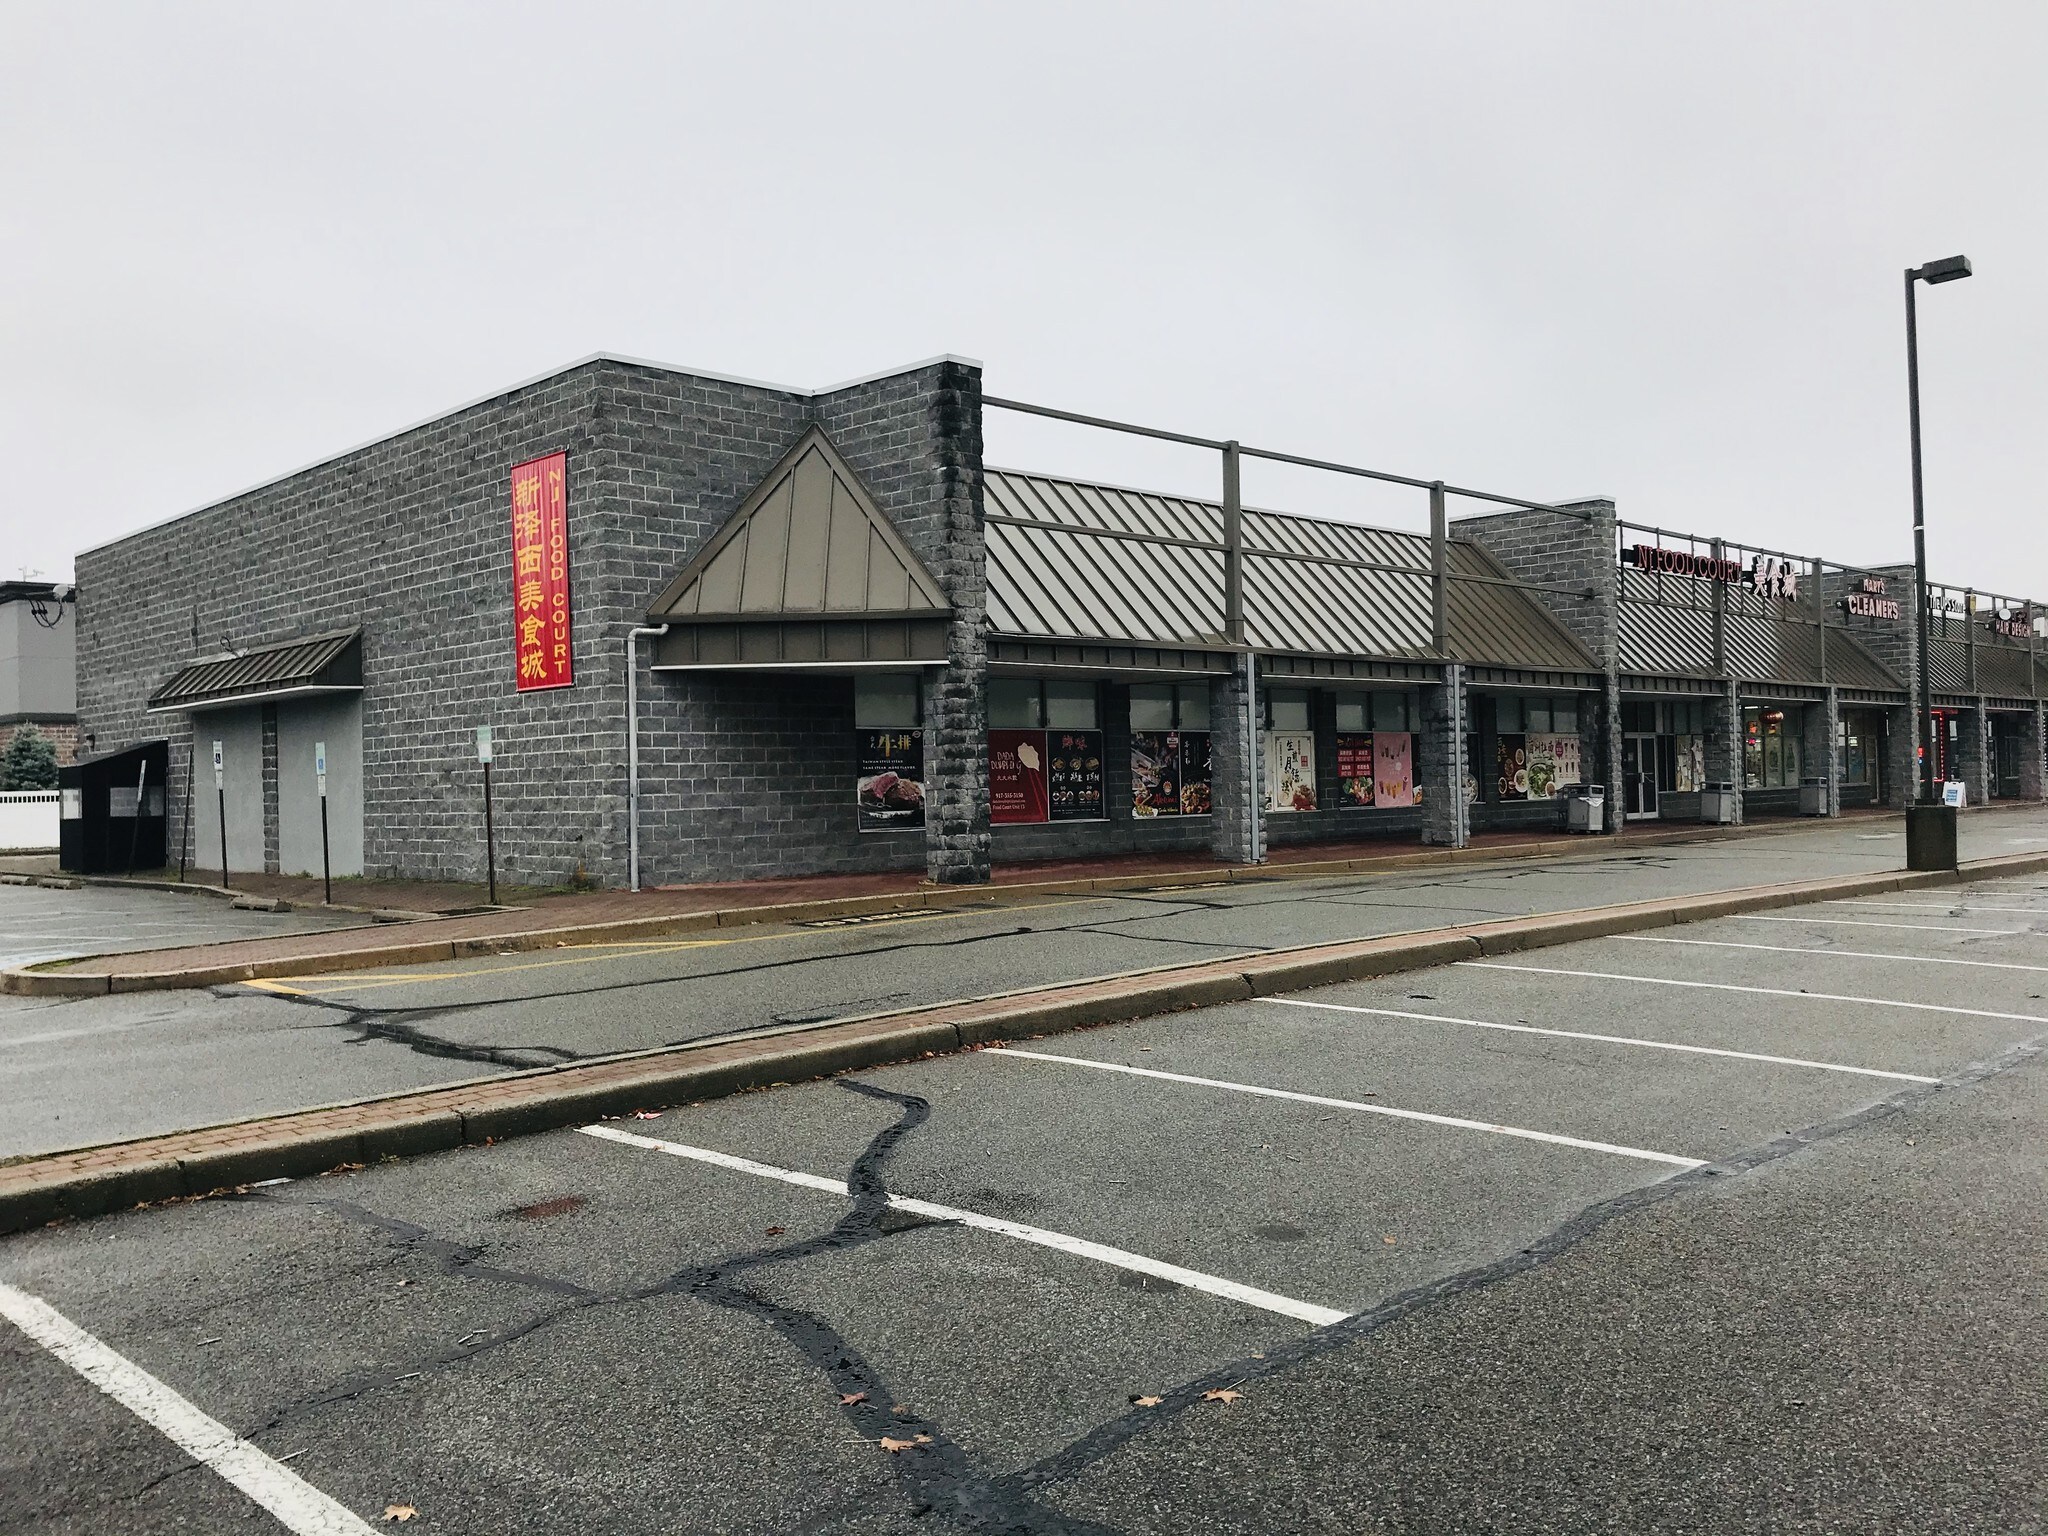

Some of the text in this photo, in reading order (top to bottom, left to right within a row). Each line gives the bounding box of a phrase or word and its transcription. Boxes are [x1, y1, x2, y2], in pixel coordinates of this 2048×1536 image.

[515, 475, 547, 680] 新泽西美食城
[549, 468, 567, 674] NJ FOOD COURT
[1656, 548, 1695, 575] FOOD
[1699, 556, 1742, 583] COURT
[1753, 555, 1797, 601] 美食城
[1848, 594, 1899, 620] CLEANERS
